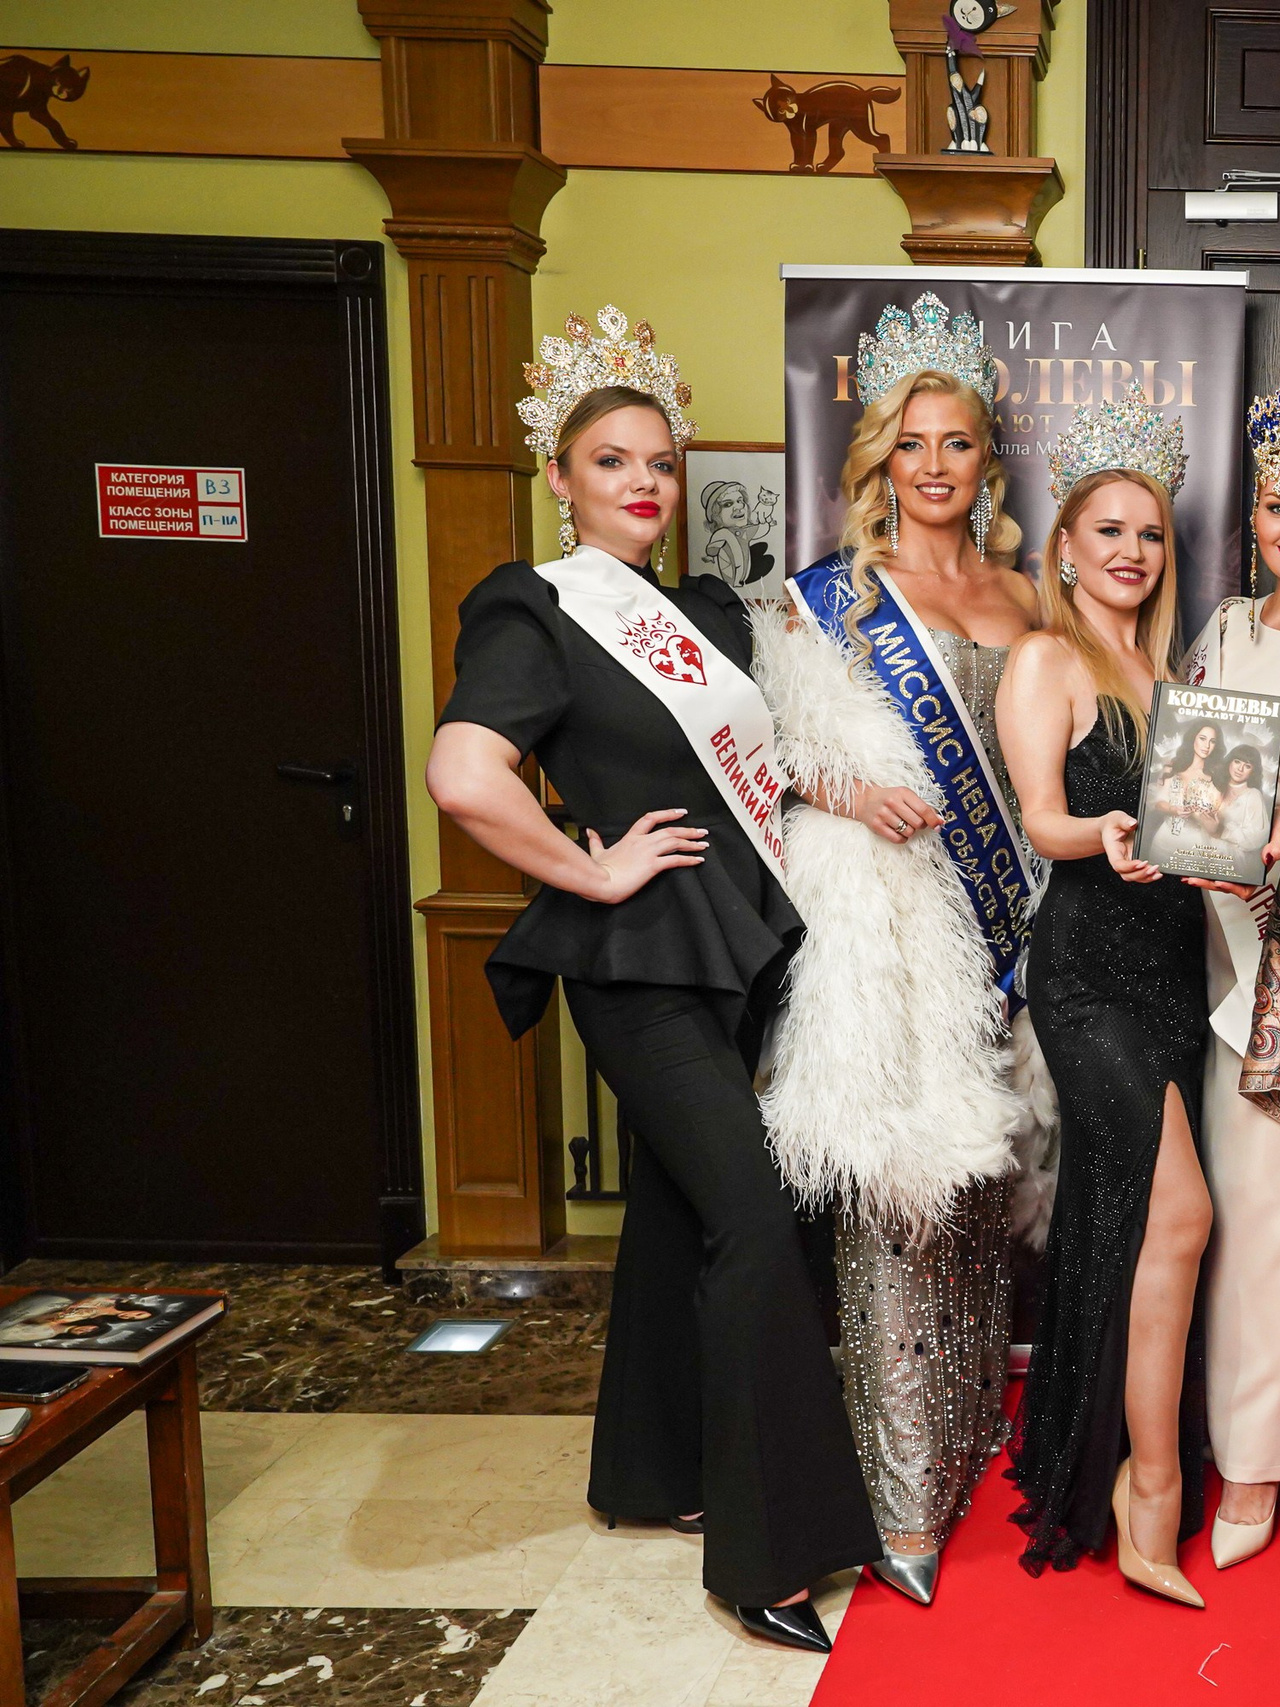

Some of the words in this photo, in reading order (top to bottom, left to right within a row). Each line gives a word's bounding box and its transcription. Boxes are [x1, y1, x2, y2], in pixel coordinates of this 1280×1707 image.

[979, 320, 1117, 351] ИГА
[111, 472, 185, 485] КАТЕГОРИЯ
[106, 486, 191, 498] ПОМЕЩЕНИЯ
[109, 506, 151, 517] КЛАСС
[154, 508, 193, 519] ЗОНЫ
[109, 519, 194, 532] ПОМЕЩЕНИЯ
[1166, 689, 1280, 718] КОРОЛЕВЫ
[1178, 707, 1236, 720] ОБНАЖАЮТ
[1237, 714, 1266, 725] ДУШУ
[868, 621, 964, 767] МИССИС
[951, 766, 998, 848] НЕВА
[710, 724, 772, 828] ВЕЛИКИЙ
[949, 828, 999, 920] ОБЛАСТЬ
